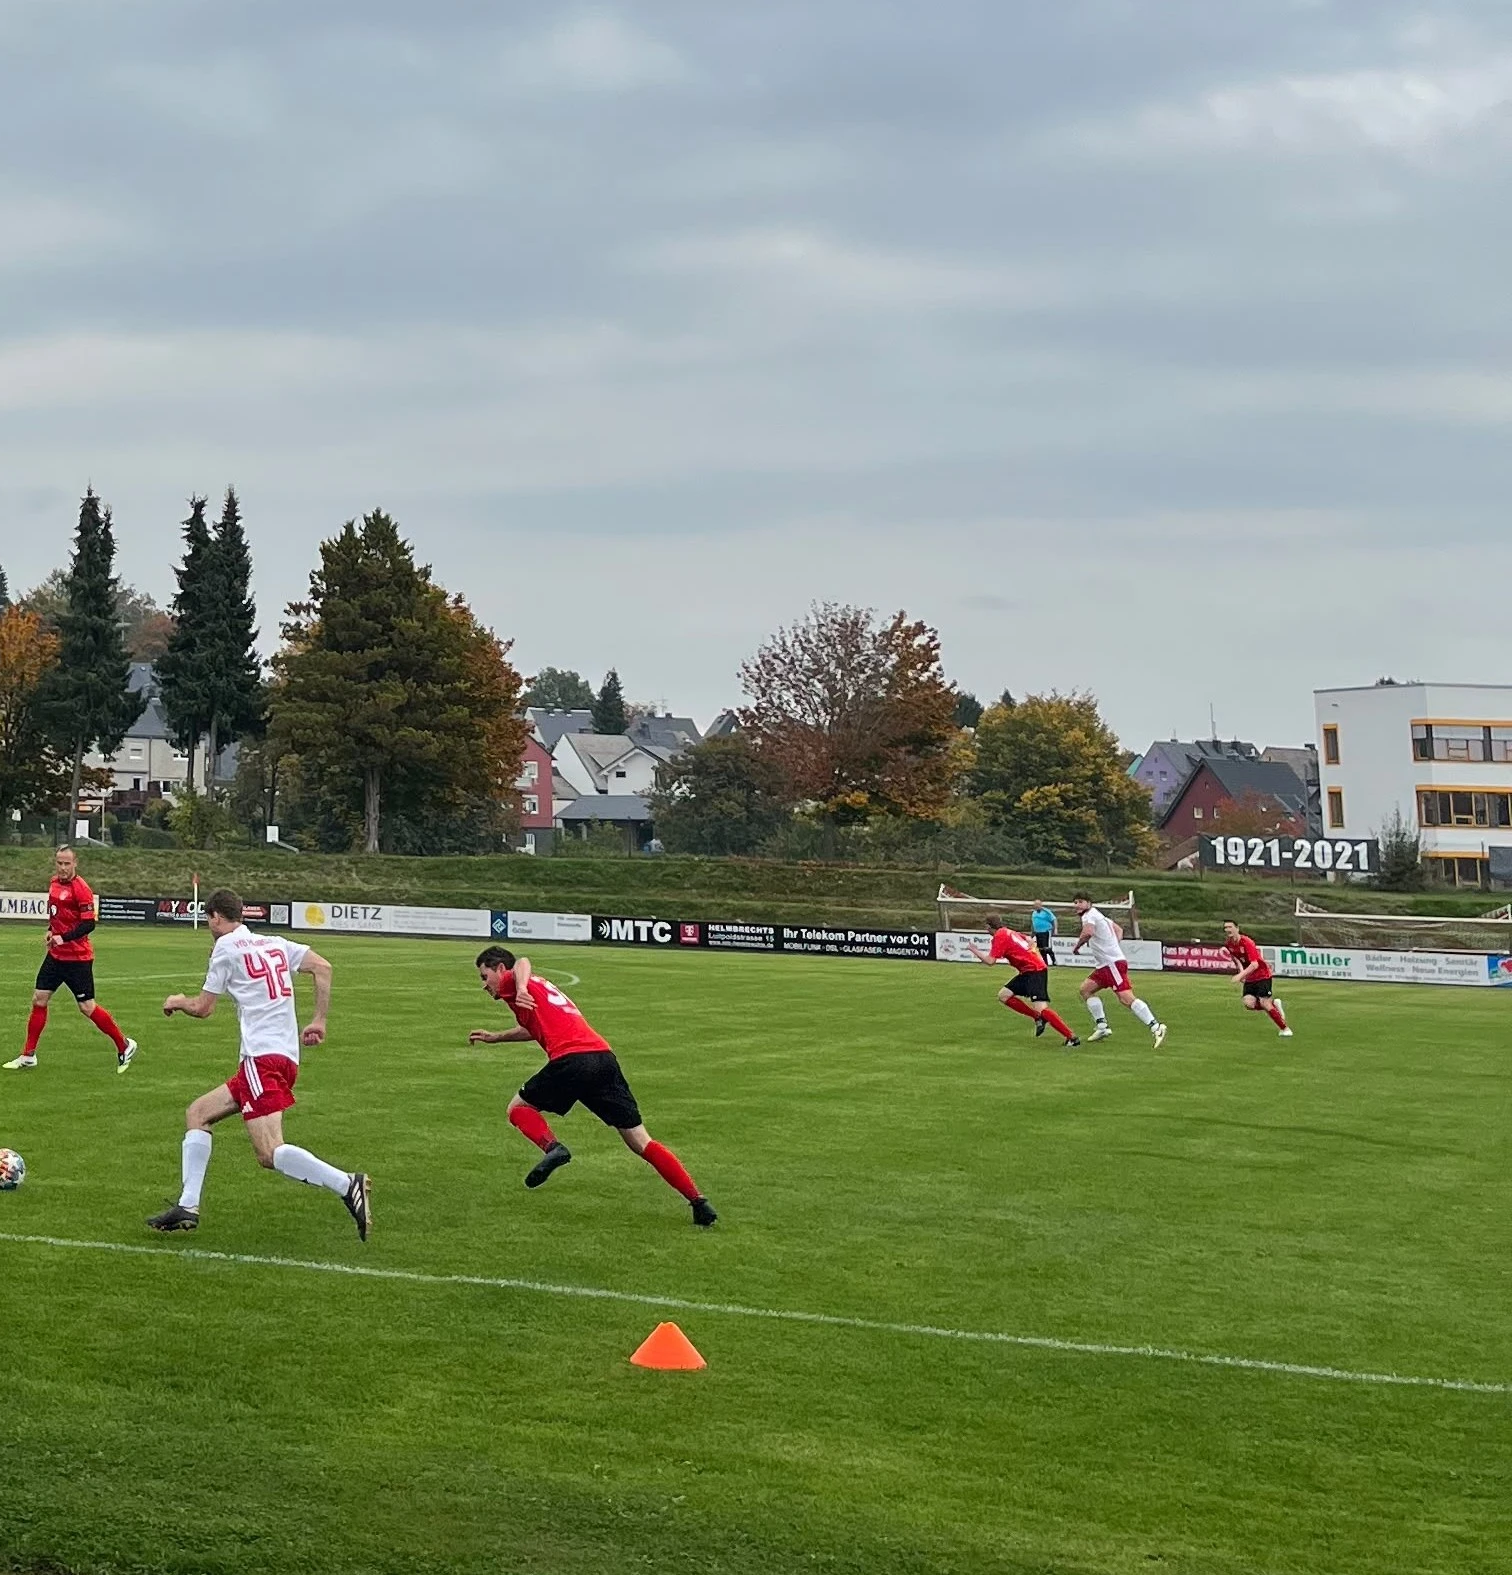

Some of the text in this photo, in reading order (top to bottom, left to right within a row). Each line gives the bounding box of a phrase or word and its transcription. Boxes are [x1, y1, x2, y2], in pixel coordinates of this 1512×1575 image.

[1210, 836, 1369, 870] 1921-2021
[331, 905, 382, 920] DIETZ
[611, 919, 672, 943] MTC
[708, 924, 775, 935] HELMBRECHTS
[783, 928, 929, 946] Ihr Telekom Partner vor Ort
[842, 945, 882, 954] GLASFASER
[1281, 949, 1351, 966] müller
[1399, 955, 1438, 966] Heizung
[243, 948, 291, 1000] 42
[1365, 964, 1479, 977] Wellness Neue Energien
